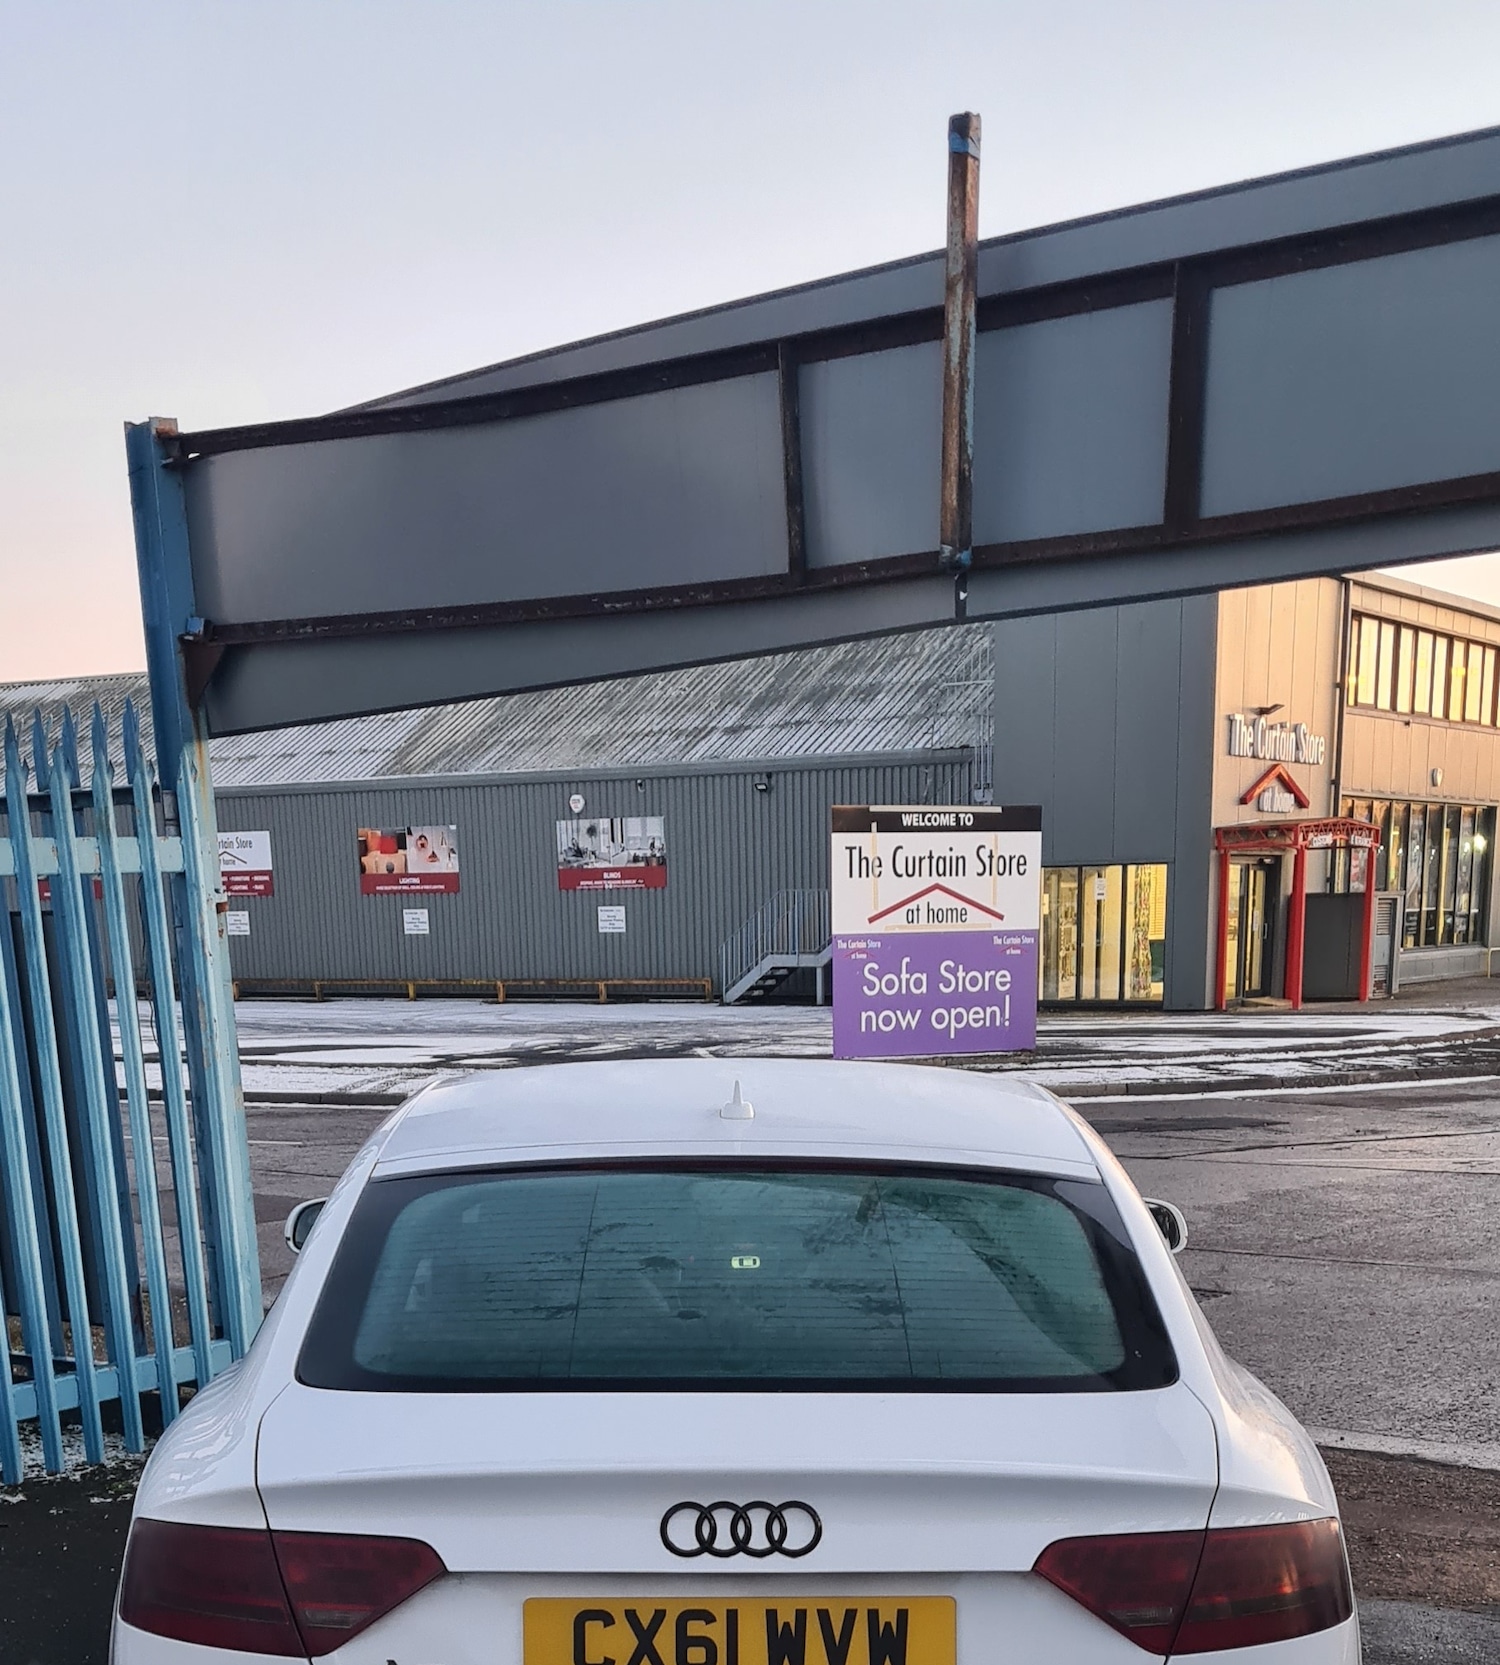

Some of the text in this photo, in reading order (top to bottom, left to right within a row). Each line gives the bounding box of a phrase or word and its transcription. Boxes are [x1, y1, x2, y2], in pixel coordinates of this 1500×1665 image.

[1230, 713, 1325, 765] The Curtain Store
[902, 813, 974, 826] WELCOME TO
[236, 837, 253, 849] Store
[845, 844, 1027, 878] The Curtain Store
[906, 902, 968, 924] at home
[862, 957, 1011, 996] Sofa Store
[860, 995, 1012, 1039] now open!
